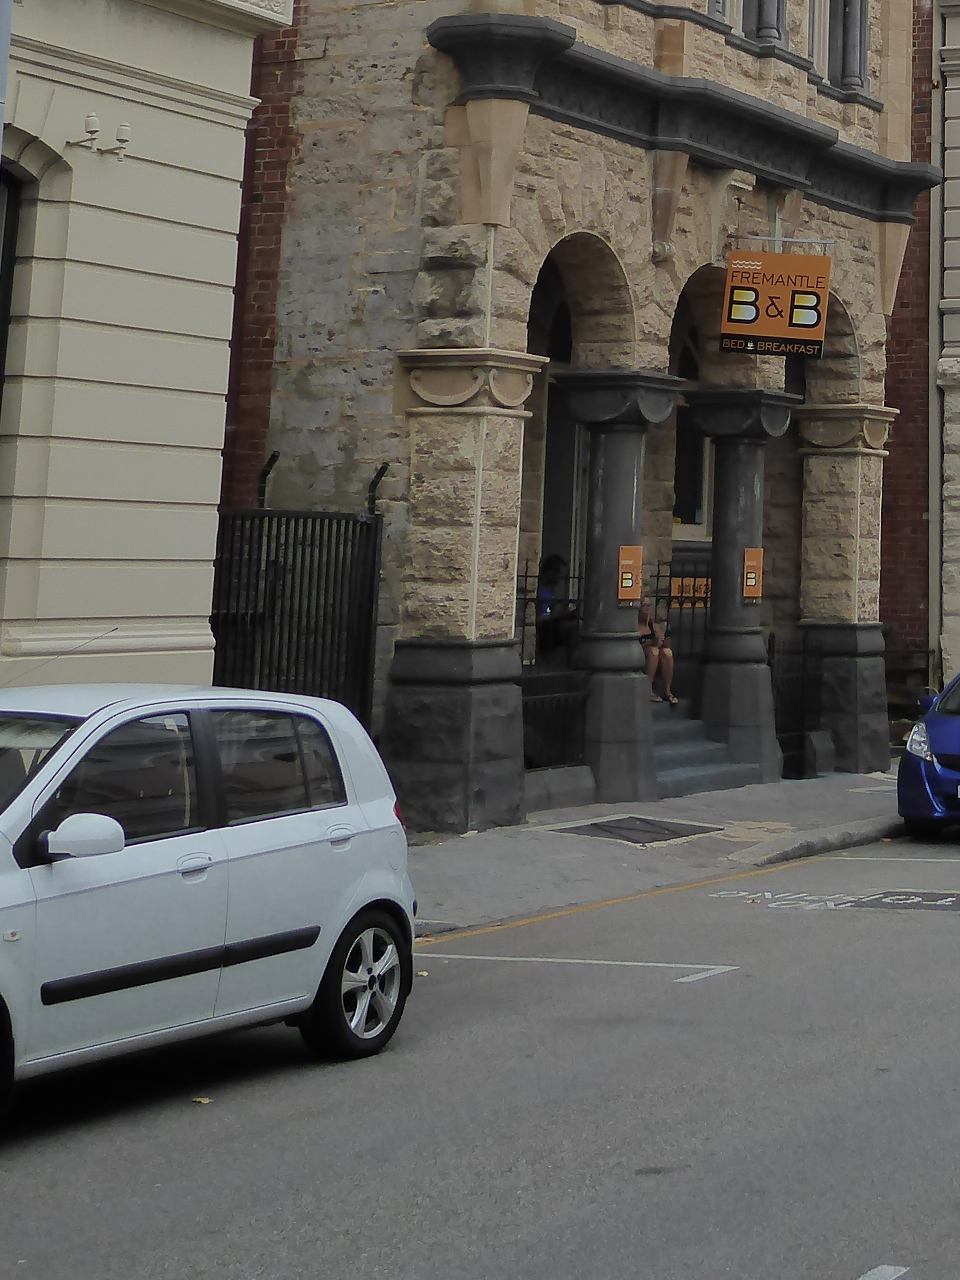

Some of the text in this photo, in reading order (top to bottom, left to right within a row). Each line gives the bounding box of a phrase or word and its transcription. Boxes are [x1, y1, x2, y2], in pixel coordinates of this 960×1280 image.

[731, 271, 826, 289] FREMANTLE
[722, 338, 820, 355] BED BREAKFAST
